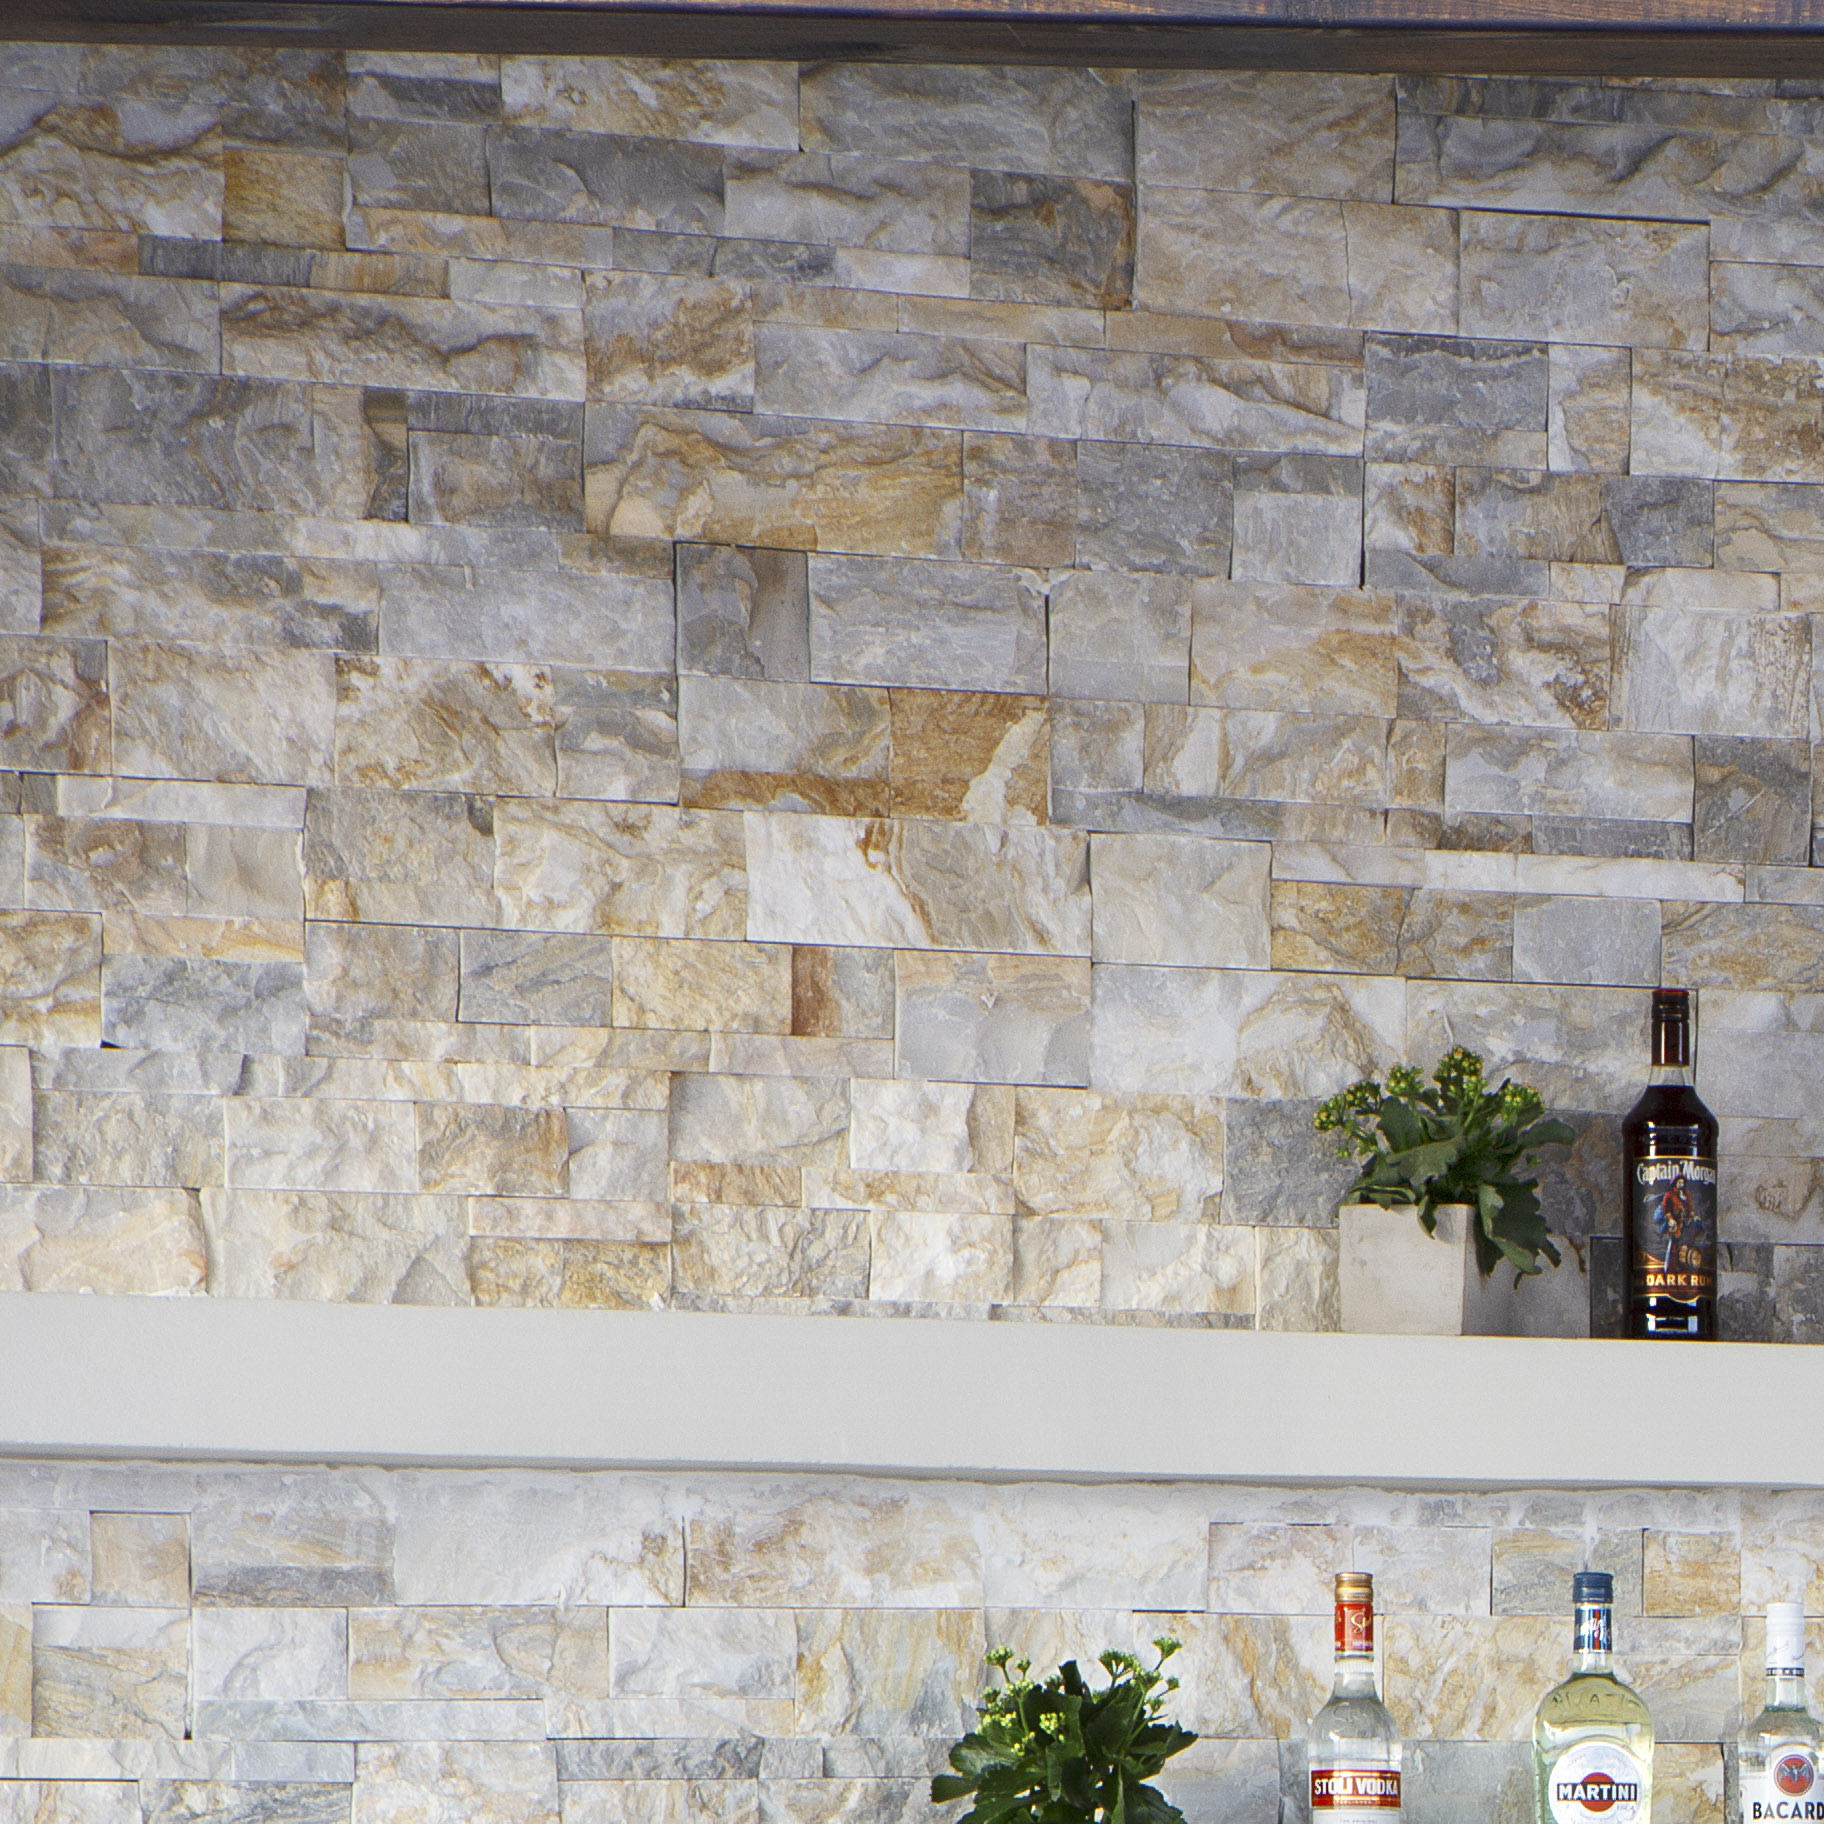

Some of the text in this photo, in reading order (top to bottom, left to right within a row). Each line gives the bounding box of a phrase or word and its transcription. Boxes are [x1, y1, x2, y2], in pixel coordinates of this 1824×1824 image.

[1637, 1159, 1717, 1186] Captain Morga
[1646, 1273, 1687, 1287] DARK
[1315, 1776, 1399, 1797] STOLI VODKA
[1557, 1783, 1638, 1801] MARTINI
